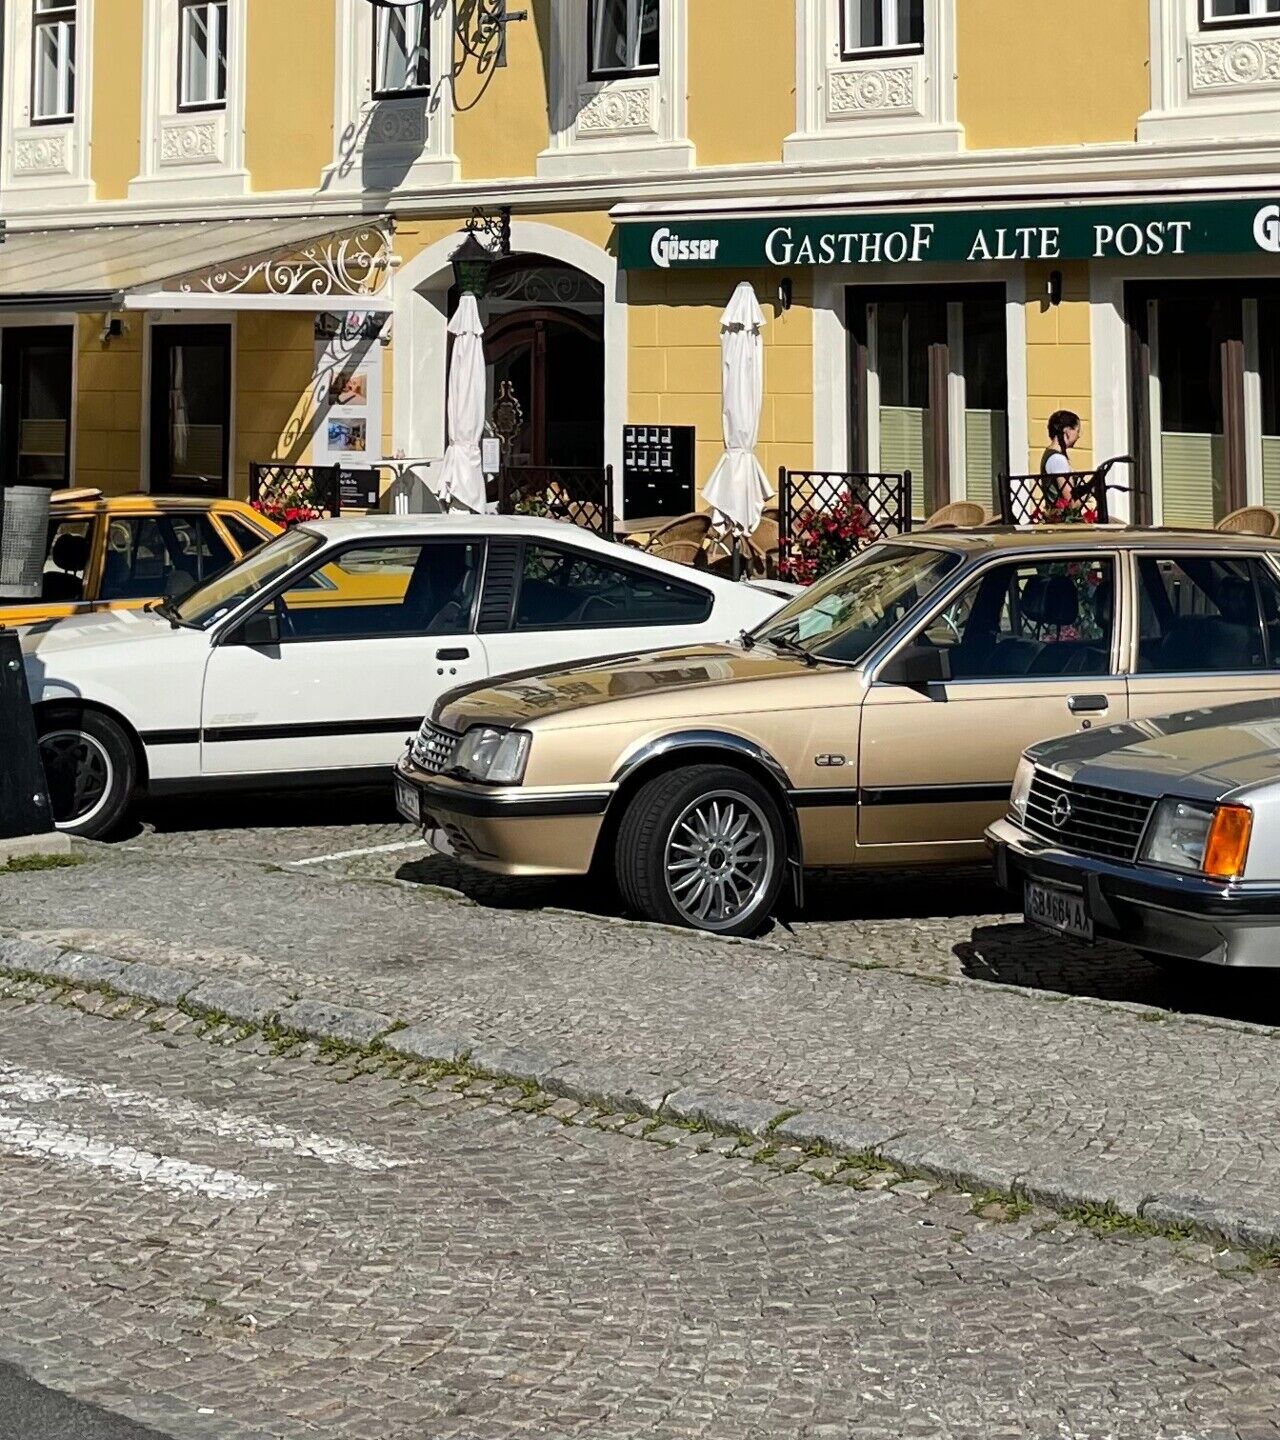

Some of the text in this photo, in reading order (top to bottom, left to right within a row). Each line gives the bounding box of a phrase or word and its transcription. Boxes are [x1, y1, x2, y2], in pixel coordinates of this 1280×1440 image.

[651, 227, 719, 268] Gösser
[764, 223, 935, 266] GASTHOF
[966, 227, 1061, 261] ALTE
[1091, 221, 1192, 257] POST
